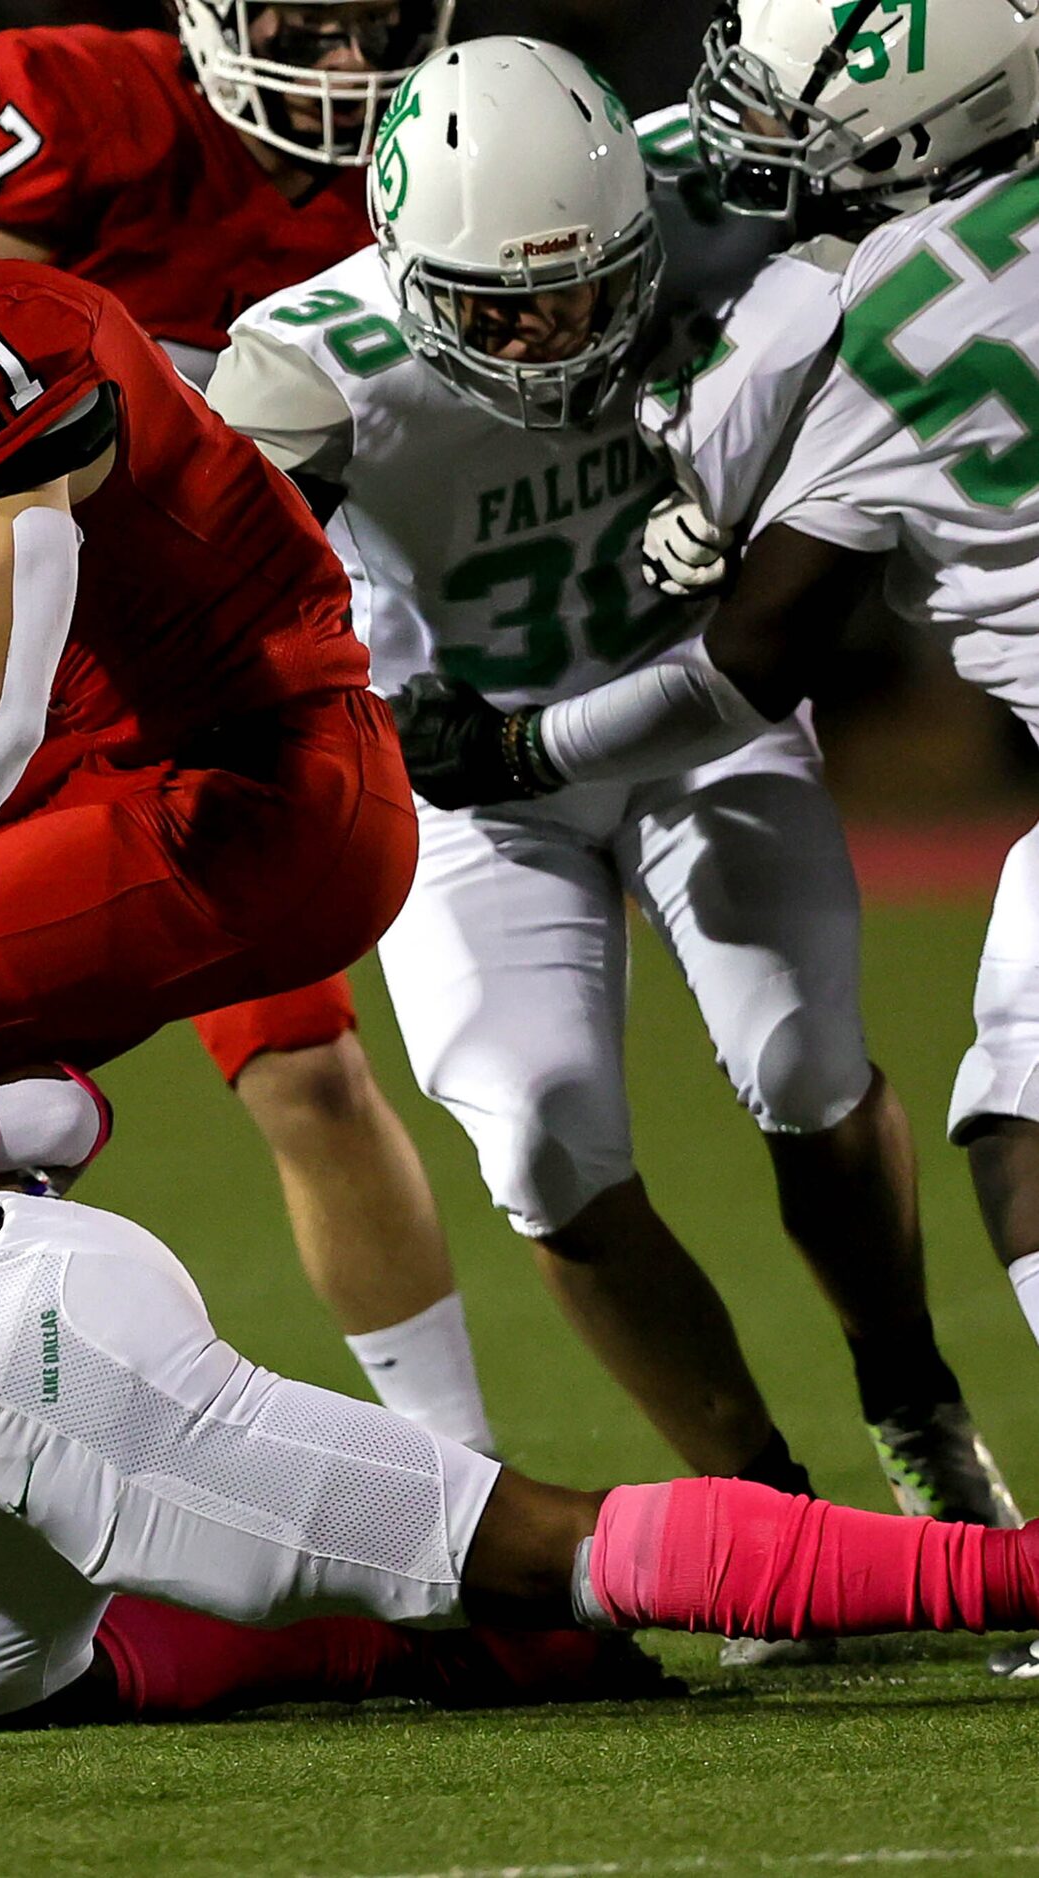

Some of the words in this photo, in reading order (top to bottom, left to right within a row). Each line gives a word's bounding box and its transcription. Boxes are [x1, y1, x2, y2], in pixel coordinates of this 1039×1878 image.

[523, 232, 578, 257] Riddell
[269, 289, 414, 379] 30
[437, 480, 700, 690] 30
[41, 1309, 60, 1363] DALLAS
[41, 1367, 59, 1404] LAKE
